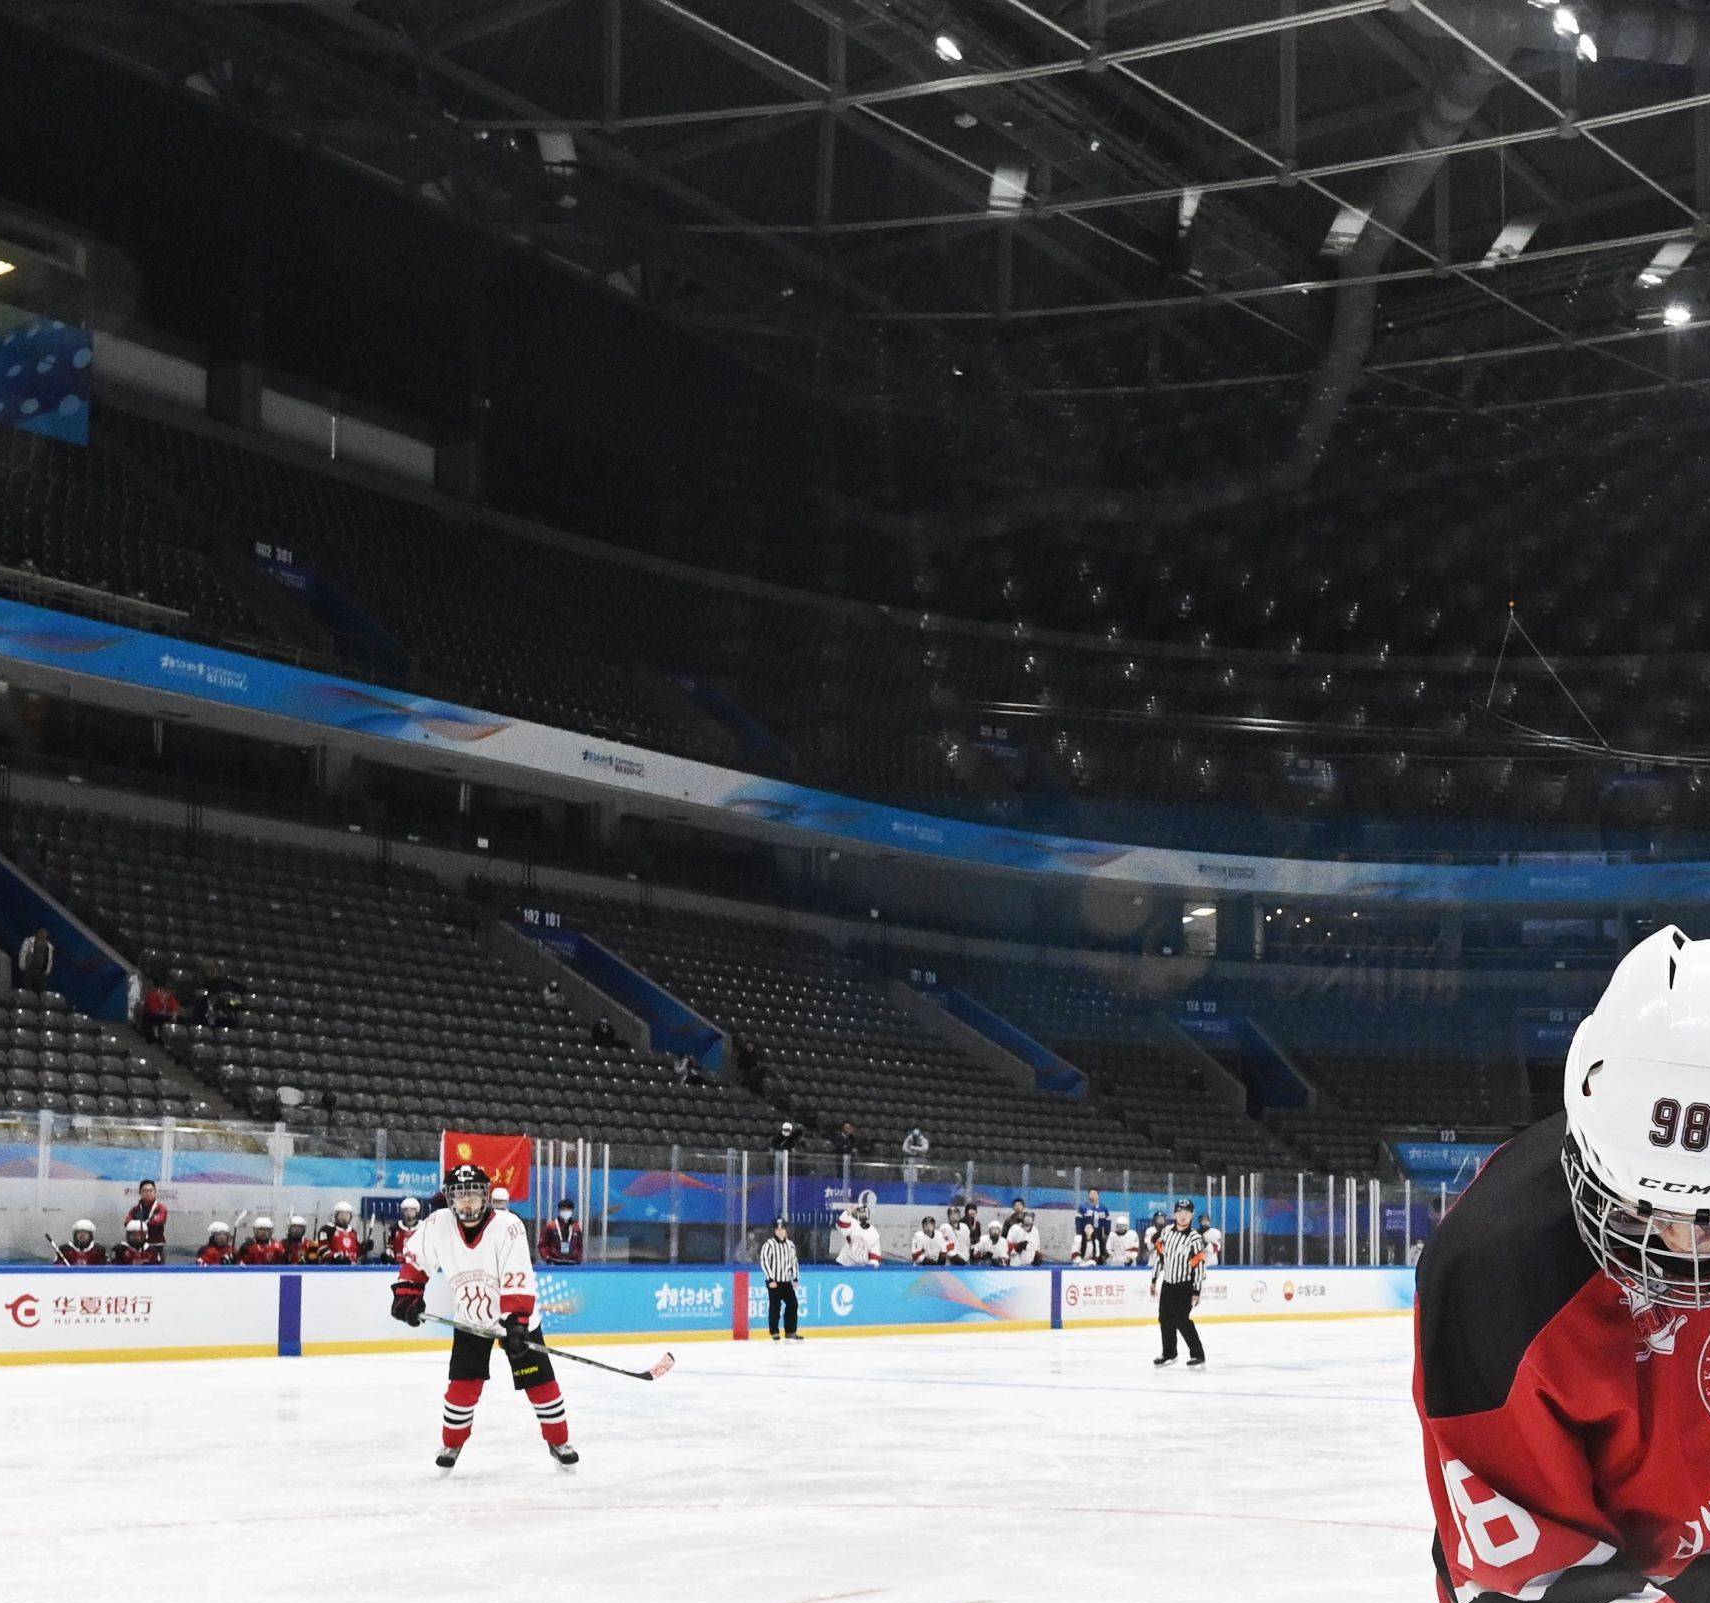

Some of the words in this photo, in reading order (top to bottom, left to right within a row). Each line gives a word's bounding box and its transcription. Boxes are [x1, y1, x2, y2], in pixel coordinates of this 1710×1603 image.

[524, 908, 540, 925] 102
[545, 911, 560, 928] 101
[1440, 1131, 1456, 1142] 123
[503, 1271, 526, 1289] 22
[53, 1296, 153, 1316] 华夏银行
